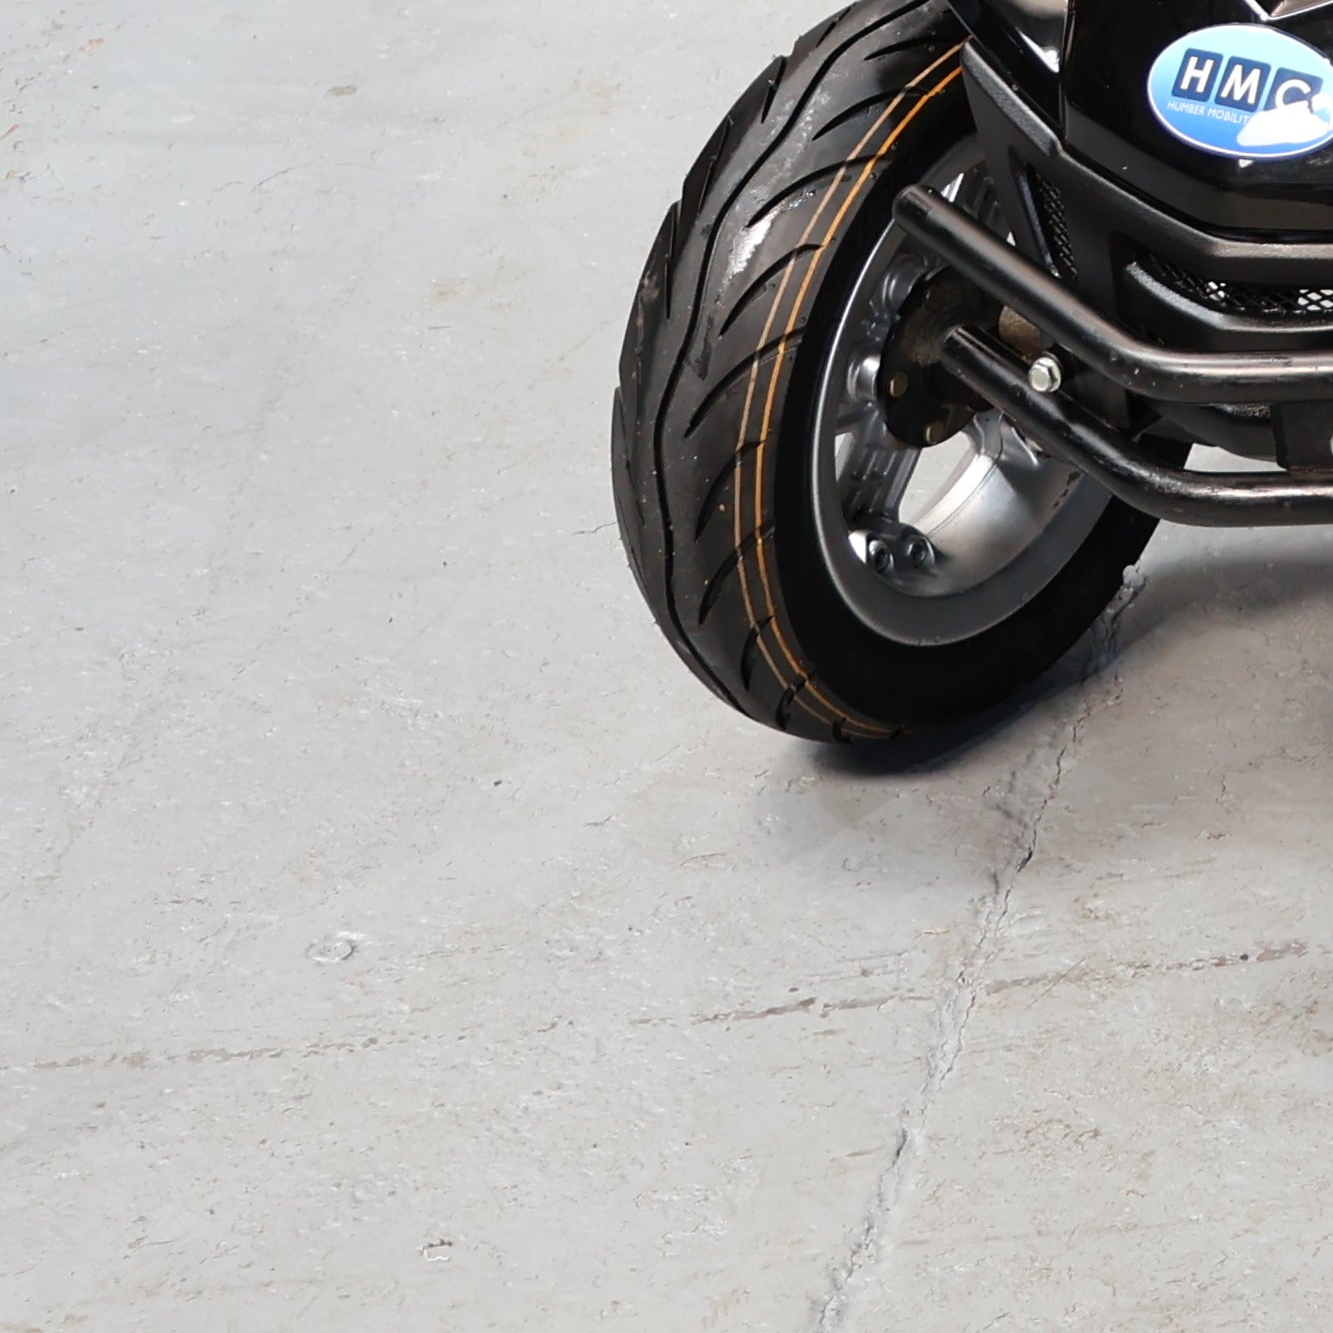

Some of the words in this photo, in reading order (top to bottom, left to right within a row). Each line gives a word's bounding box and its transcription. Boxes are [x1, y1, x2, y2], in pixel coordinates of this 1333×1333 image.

[1179, 56, 1312, 111] HMC
[1166, 100, 1206, 116] HUMBER
[1207, 107, 1251, 125] MOBILIT
